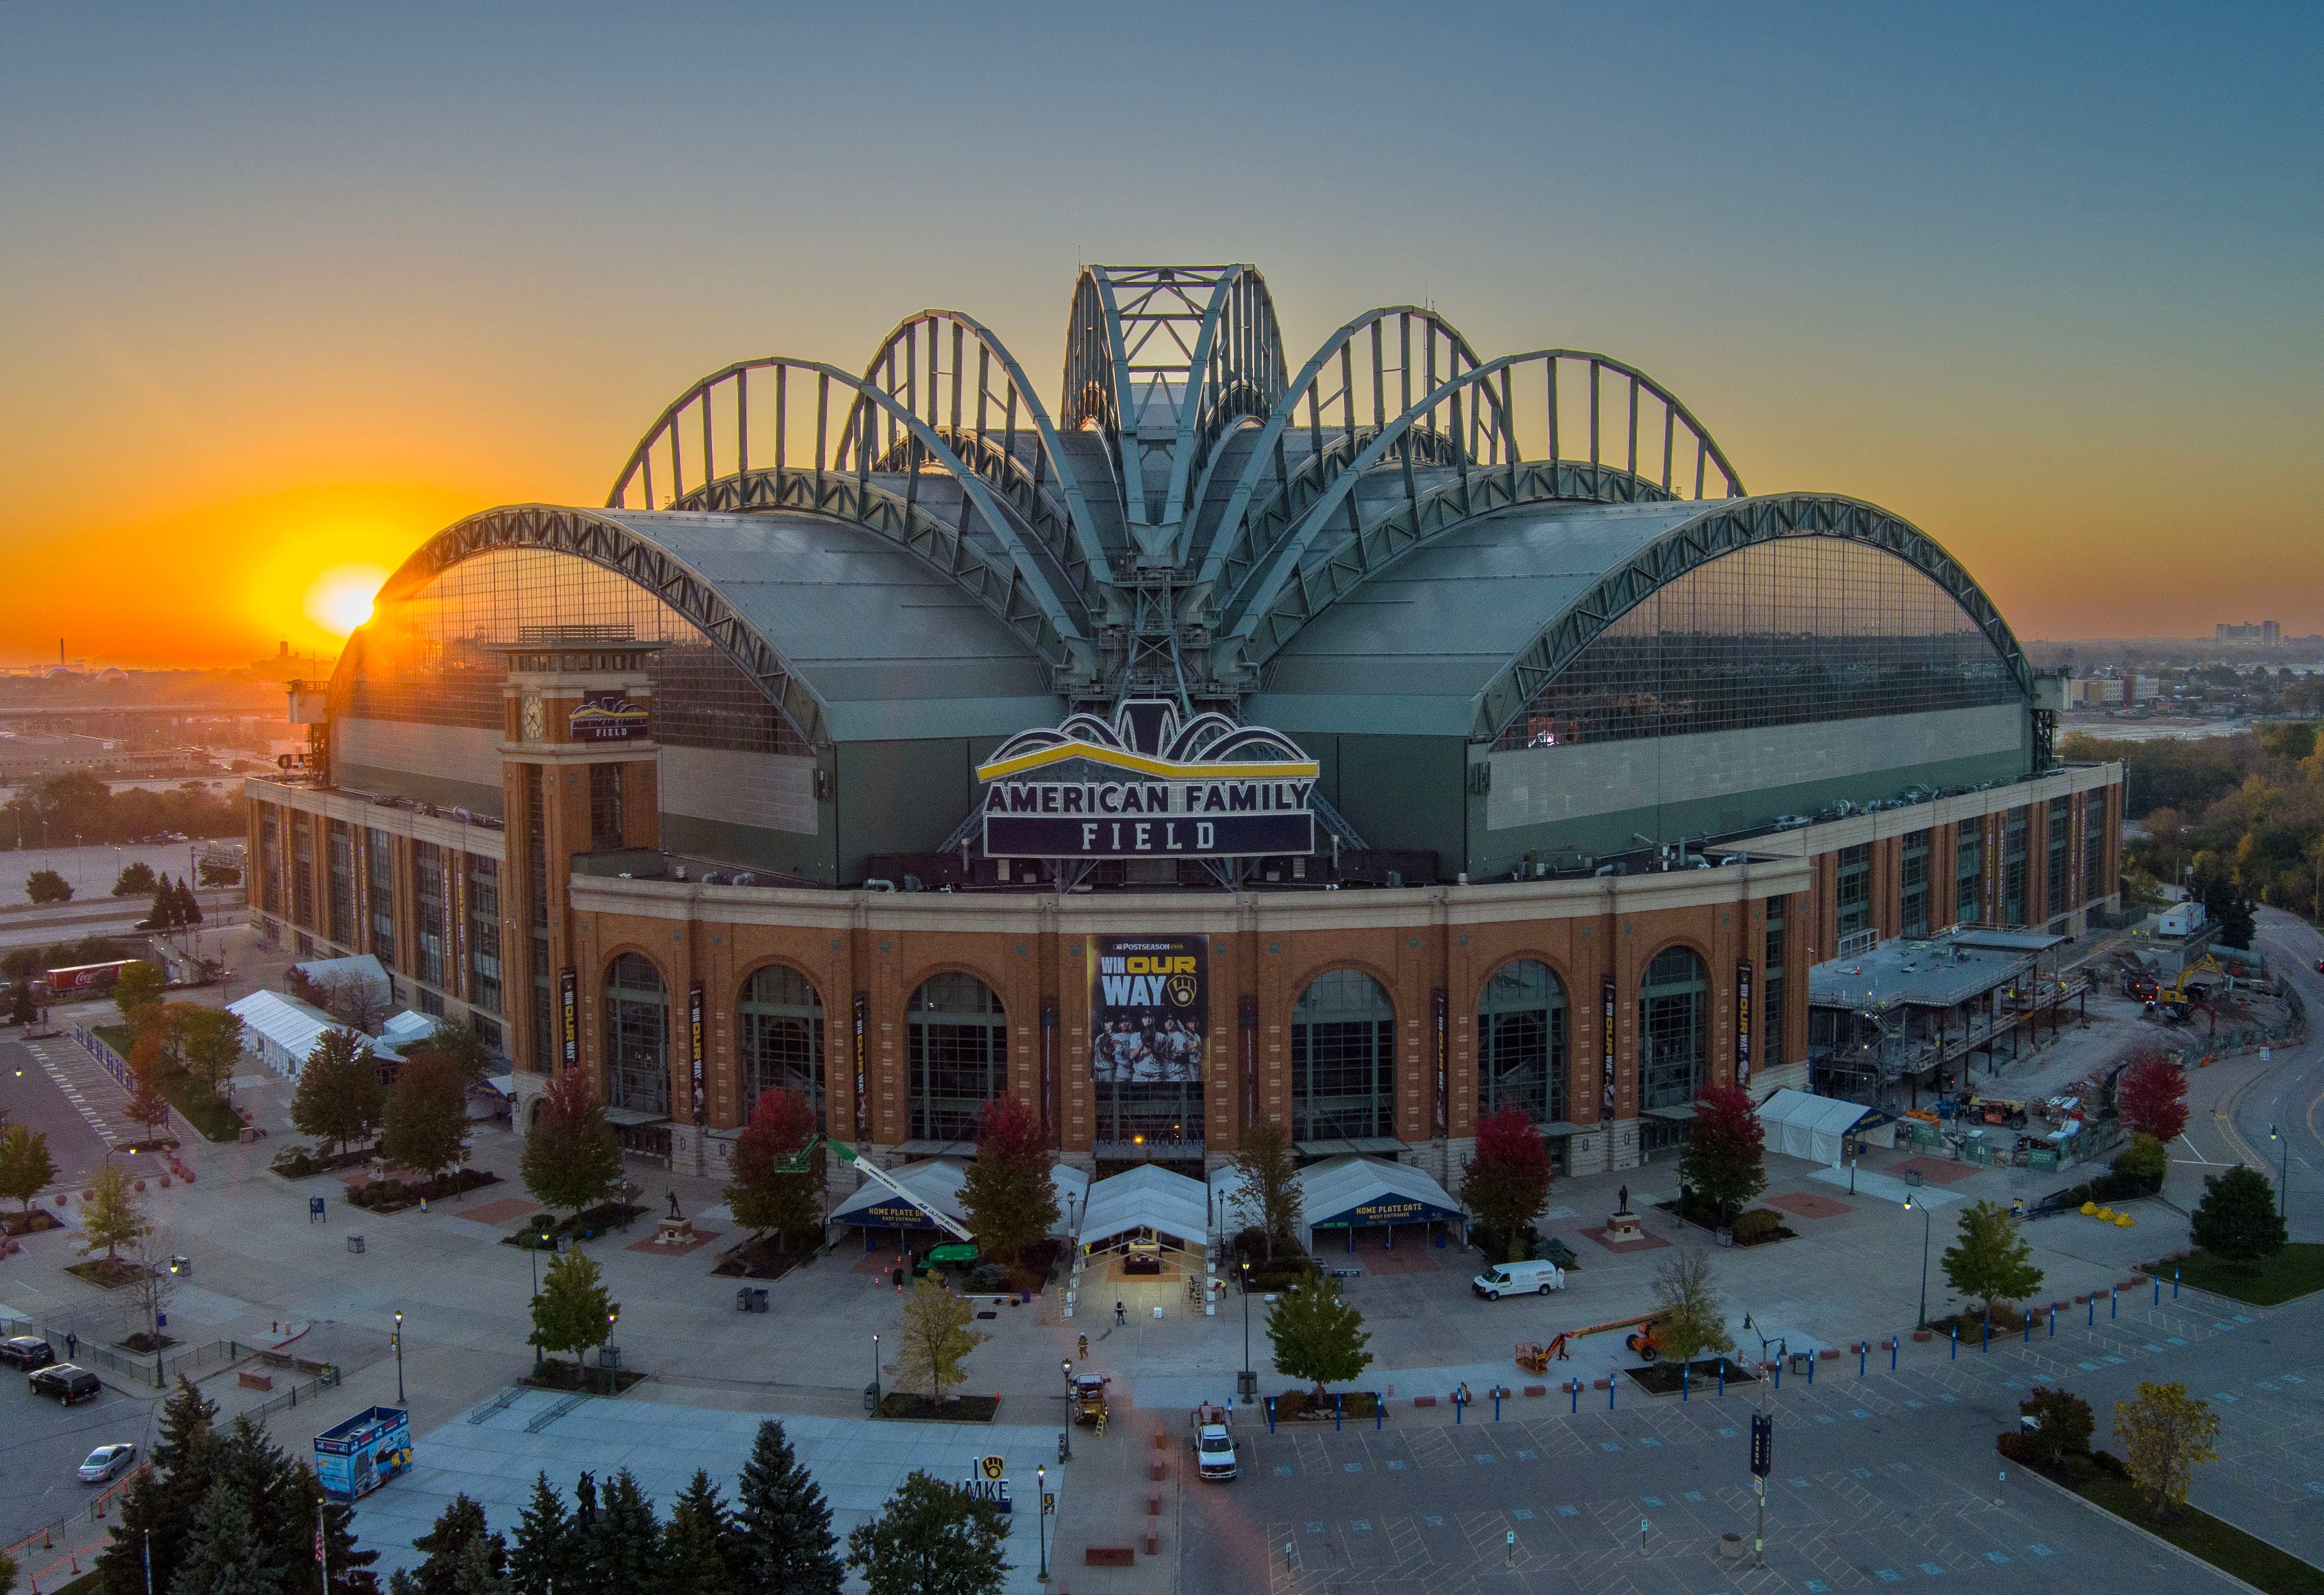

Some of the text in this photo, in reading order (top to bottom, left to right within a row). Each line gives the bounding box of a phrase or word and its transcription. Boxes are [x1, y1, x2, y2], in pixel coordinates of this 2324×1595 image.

[596, 728, 627, 737] FIELD
[986, 782, 1312, 813] AMERICAN FAMILY
[1082, 822, 1215, 851] FIELD
[1101, 957, 1196, 974] WIN OUR
[1101, 975, 1167, 1006] WAY
[564, 991, 575, 1060] WIN OUR WAY
[1739, 984, 1749, 1054] WIN OUR WAY
[693, 1022, 702, 1060] OUR
[693, 1060, 702, 1079] WAY
[1144, 1139, 1169, 1152] TEAM
[1174, 1139, 1205, 1152] STORE
[868, 1168, 897, 1190] SUNBELT RENTALS
[928, 1209, 946, 1222] ULTRA
[944, 1220, 961, 1232] BOOM
[973, 1456, 979, 1480] I
[965, 1478, 1010, 1502] MKE
